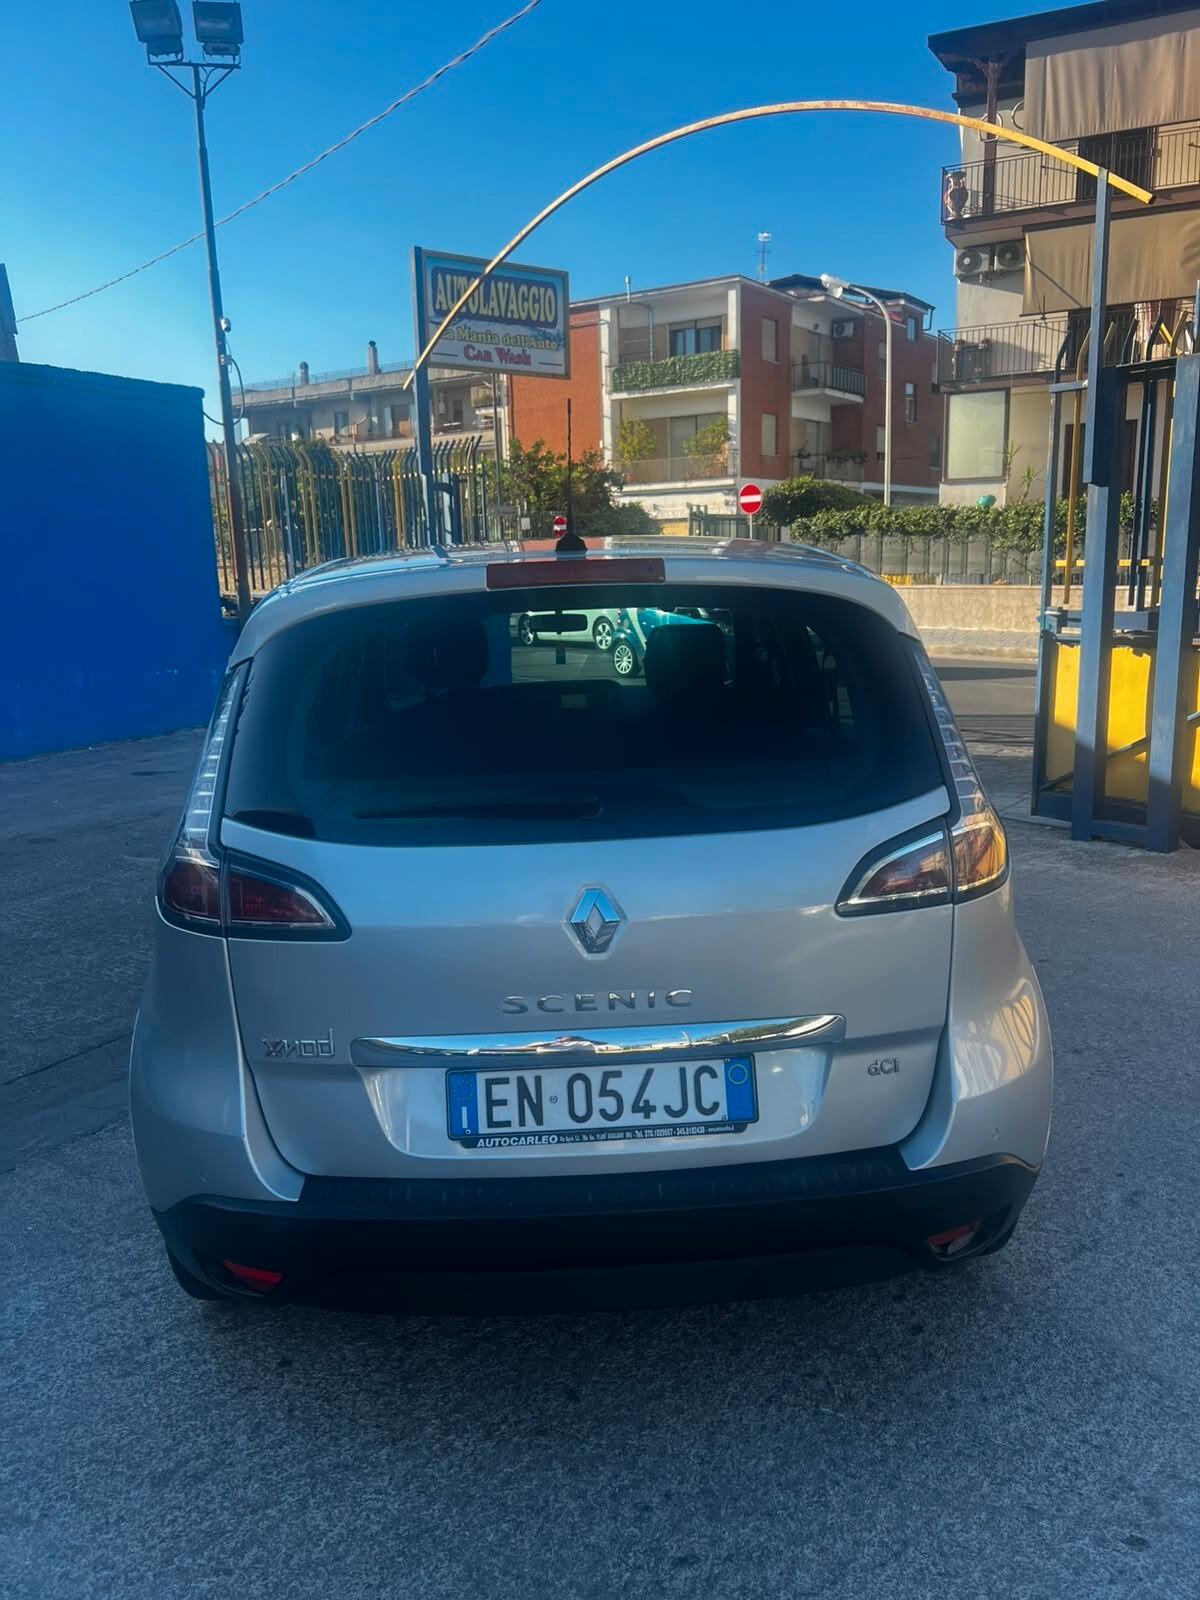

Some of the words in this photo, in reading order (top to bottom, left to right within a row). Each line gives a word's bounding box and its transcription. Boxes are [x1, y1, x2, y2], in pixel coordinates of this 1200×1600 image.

[435, 272, 556, 323] AUTOLAVAGGIO
[456, 326, 500, 345] Mania
[502, 989, 693, 1014] SCENIC
[485, 1075, 544, 1129] EN
[566, 1064, 720, 1124] 054JC
[477, 1134, 558, 1148] AUTOCARLEO
